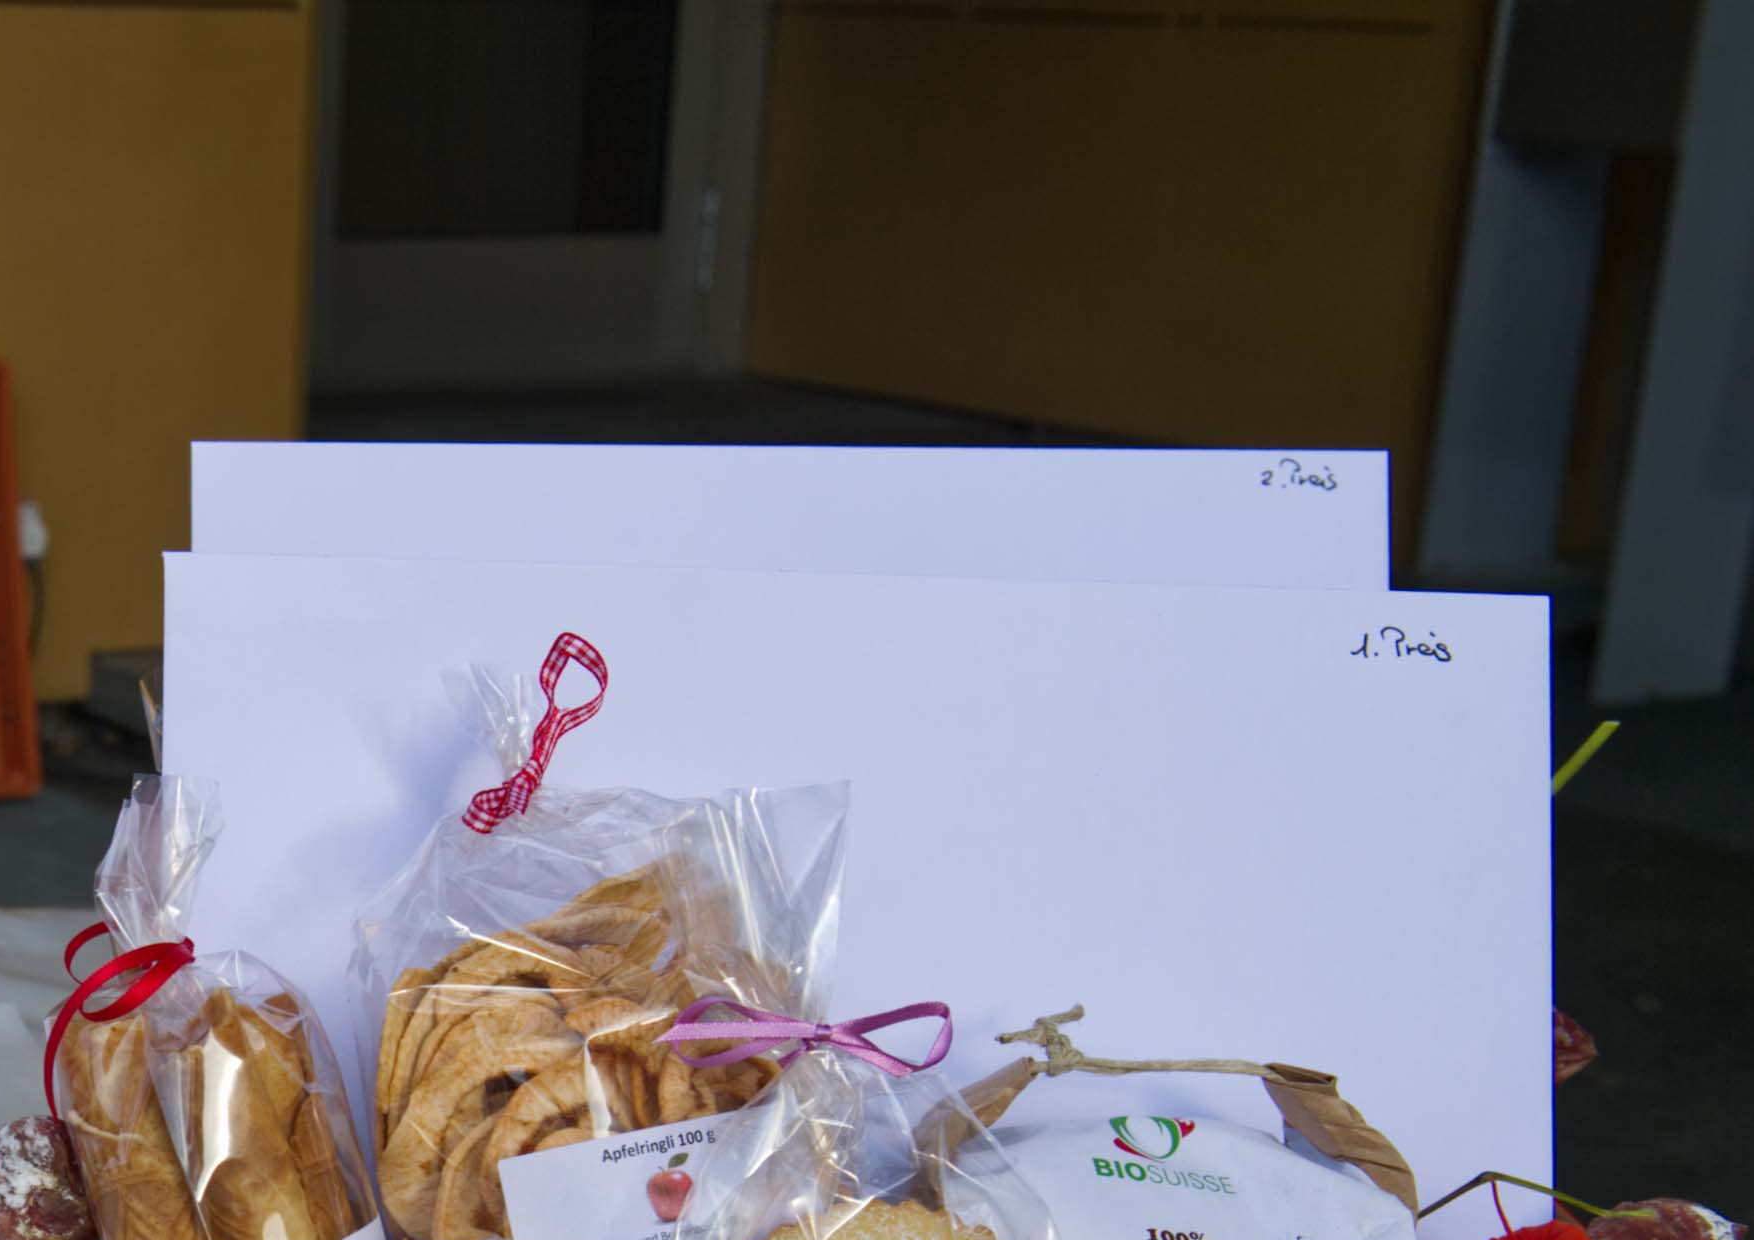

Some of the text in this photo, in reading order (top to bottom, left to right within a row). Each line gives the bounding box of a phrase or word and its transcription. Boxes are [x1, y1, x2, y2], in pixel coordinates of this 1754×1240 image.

[601, 1129, 717, 1163] Apfelringli 100 g
